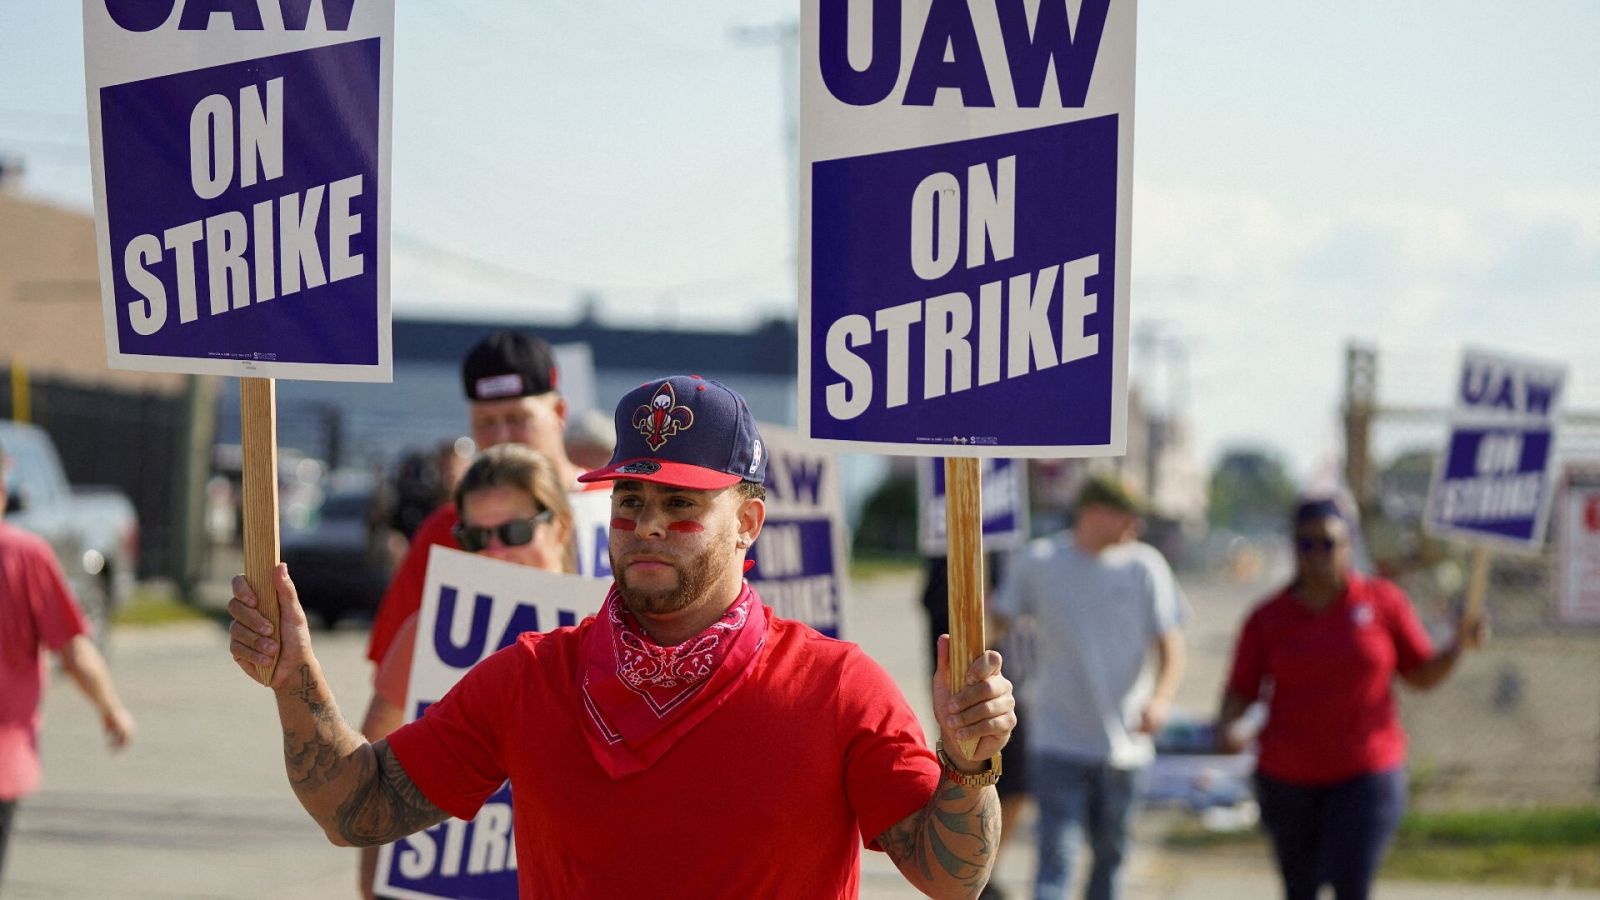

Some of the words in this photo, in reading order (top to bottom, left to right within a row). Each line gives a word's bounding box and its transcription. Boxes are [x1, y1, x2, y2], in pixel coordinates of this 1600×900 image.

[819, 0, 1111, 108] UAW
[189, 76, 284, 200] ON
[124, 173, 364, 336] STRIKE
[911, 154, 1016, 281] ON
[825, 253, 1100, 421] STRIKE
